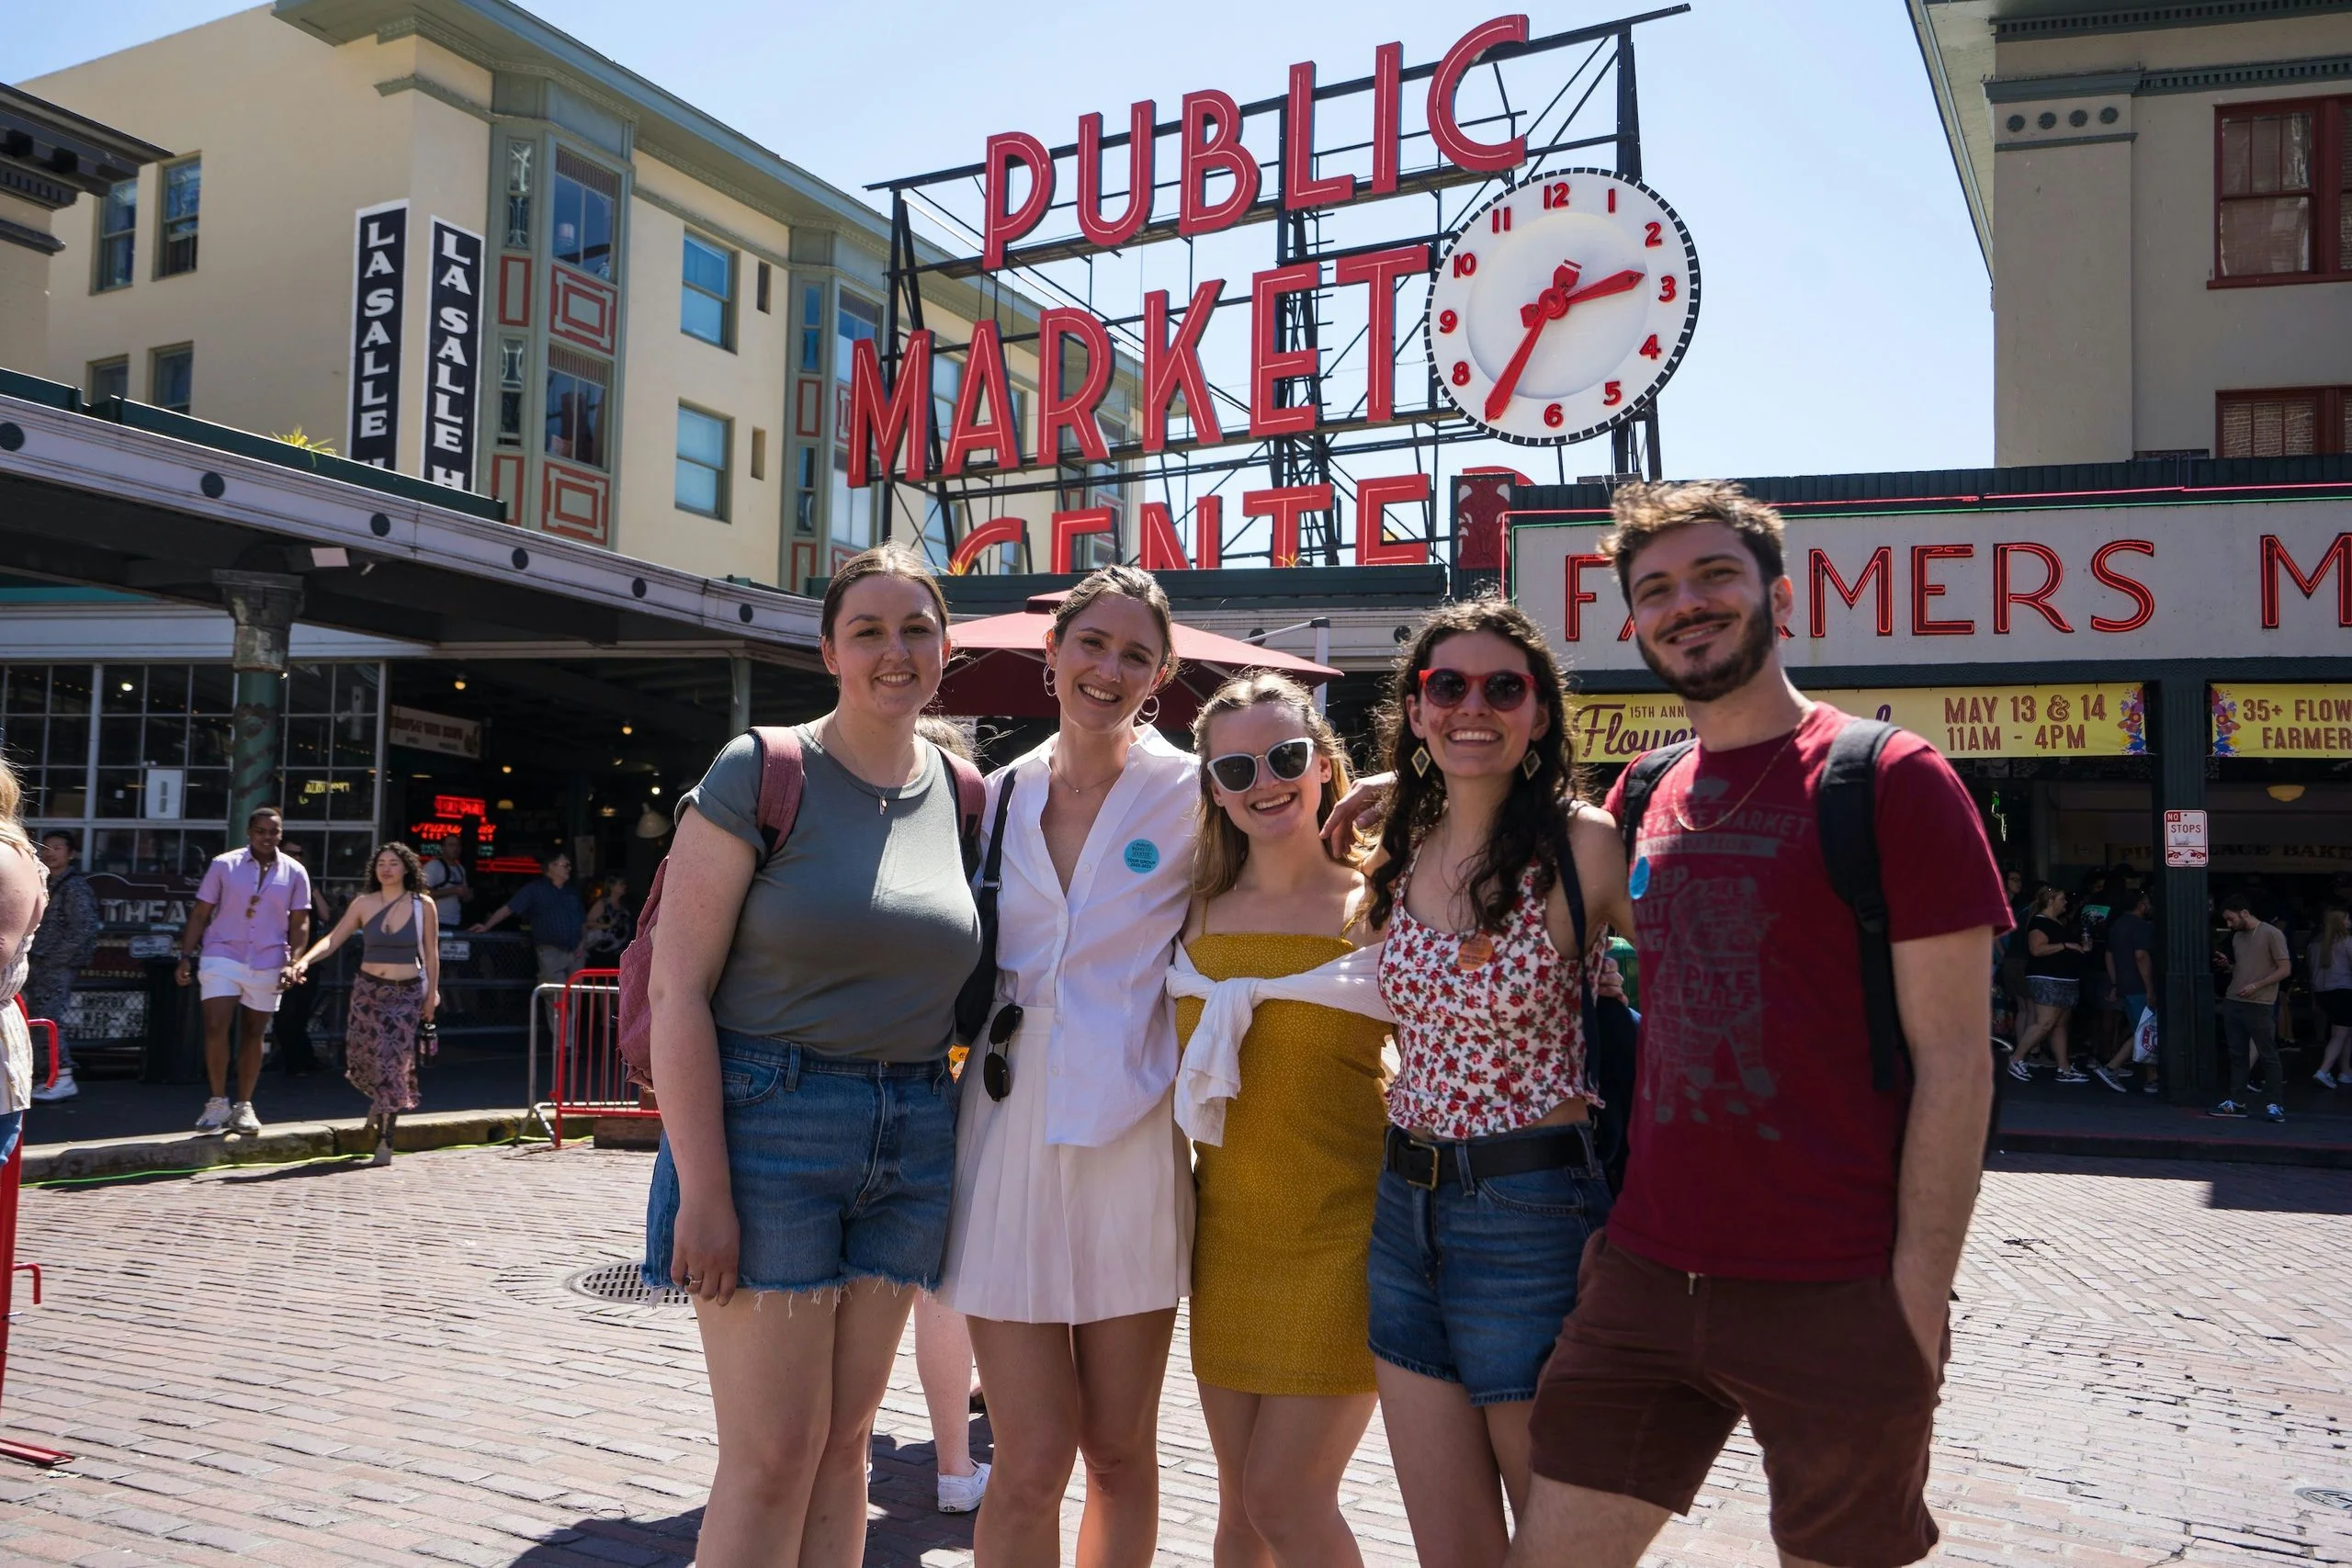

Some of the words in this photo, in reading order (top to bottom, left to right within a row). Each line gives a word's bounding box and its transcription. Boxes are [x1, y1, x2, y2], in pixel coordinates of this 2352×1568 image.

[983, 14, 1529, 271] PUBLIC
[1544, 182, 1570, 209] 12
[1608, 188, 1616, 213] 1
[1492, 207, 1511, 234] 11
[1645, 221, 1663, 248] 2
[364, 221, 395, 278] LA
[440, 231, 471, 296] LA
[1453, 252, 1476, 278] 10
[1658, 276, 1677, 302] 3
[1439, 310, 1458, 334] 9
[1639, 333, 1662, 360] 4
[359, 288, 394, 438] SALLE
[847, 244, 1430, 488] MARKET
[1452, 361, 1471, 386] 8
[434, 306, 469, 453] SALLE
[1603, 381, 1623, 406] 5
[1544, 403, 1565, 428] 6
[1565, 540, 2154, 642] FMERS
[1630, 706, 1655, 718] 15TH
[1660, 705, 1688, 718] ANN
[1944, 696, 1999, 724] MAY
[2010, 694, 2037, 723] 13
[2047, 694, 2070, 722] &
[2080, 694, 2107, 721] 14
[2243, 698, 2283, 722] 35+
[2294, 698, 2352, 722] FLOW
[1947, 726, 2001, 751] 11AM
[2034, 725, 2086, 750] 4PM
[2262, 727, 2352, 750] FARMER
[2171, 824, 2201, 833] STOPS
